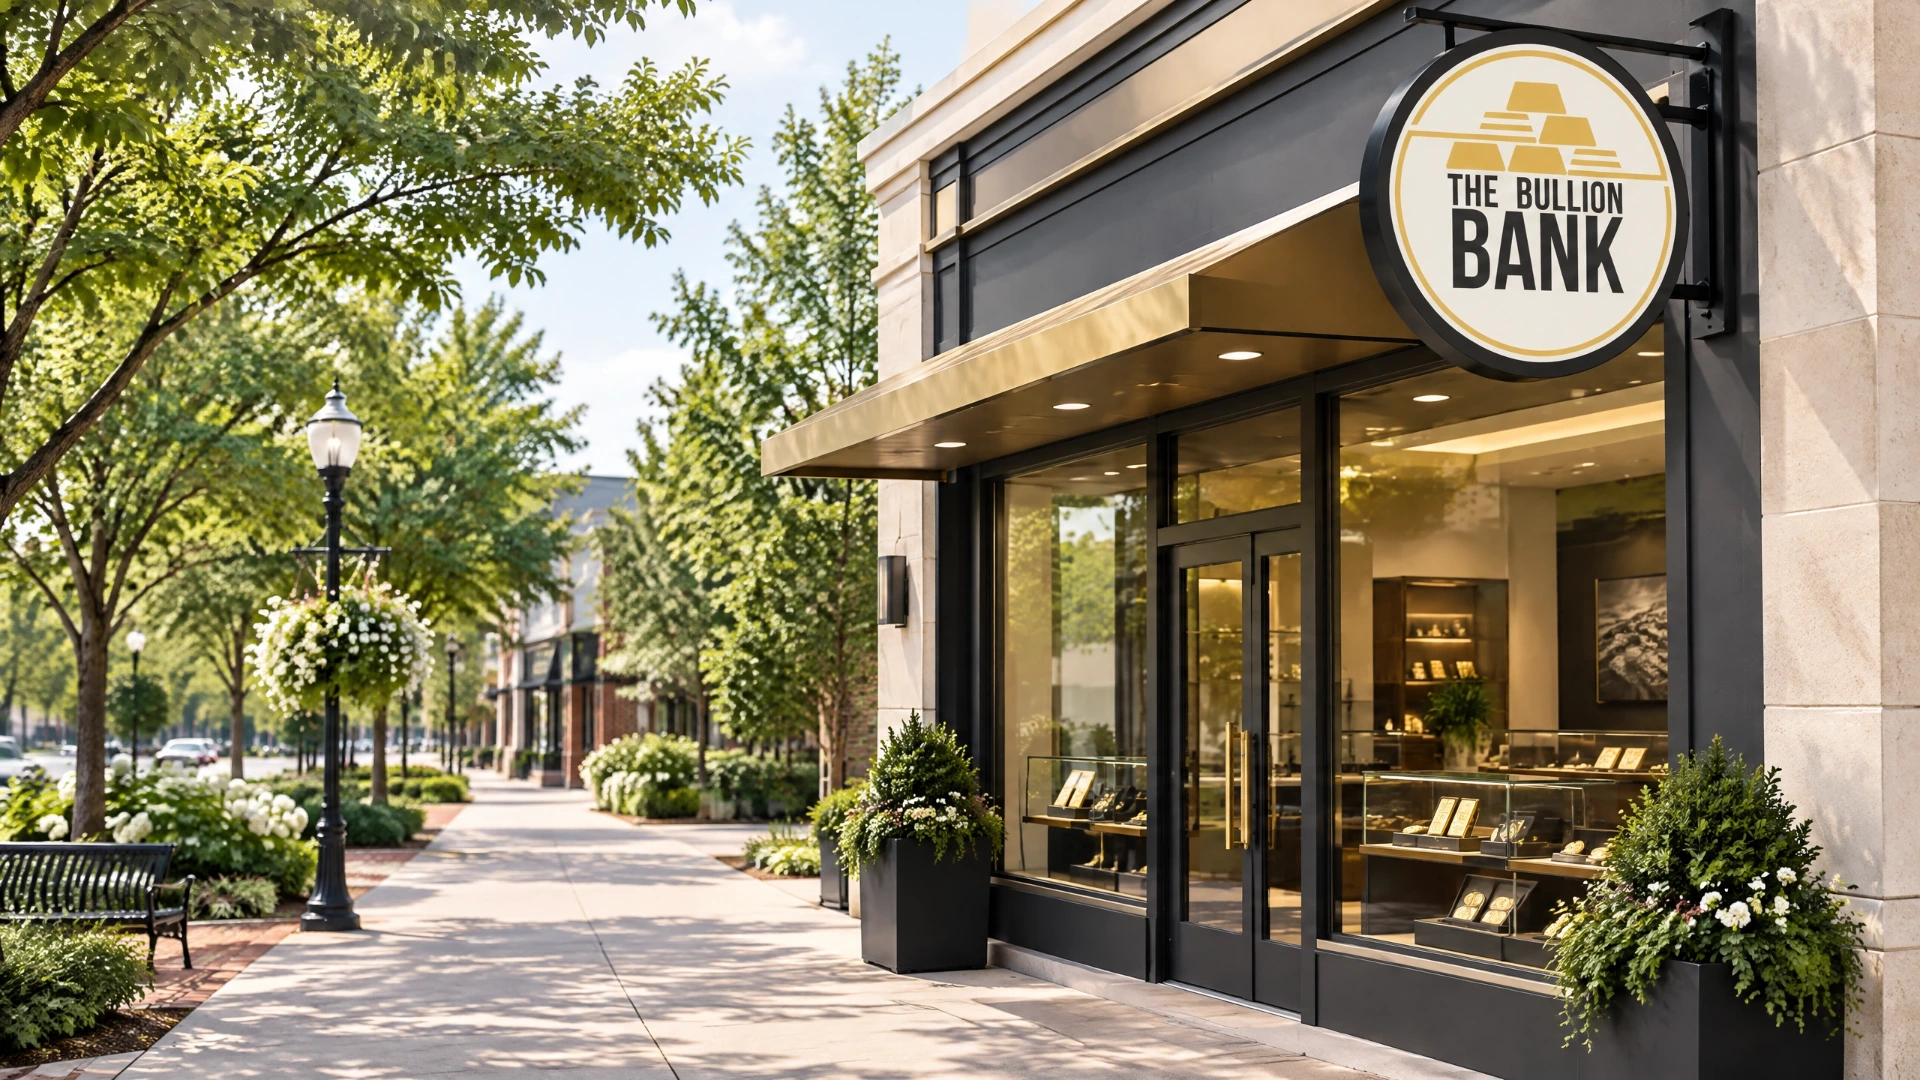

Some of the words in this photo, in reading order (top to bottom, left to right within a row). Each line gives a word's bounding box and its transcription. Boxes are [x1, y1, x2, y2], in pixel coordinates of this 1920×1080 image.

[1447, 173, 1499, 207] THE
[1516, 176, 1623, 214] BULLION
[1452, 208, 1624, 293] BANK
